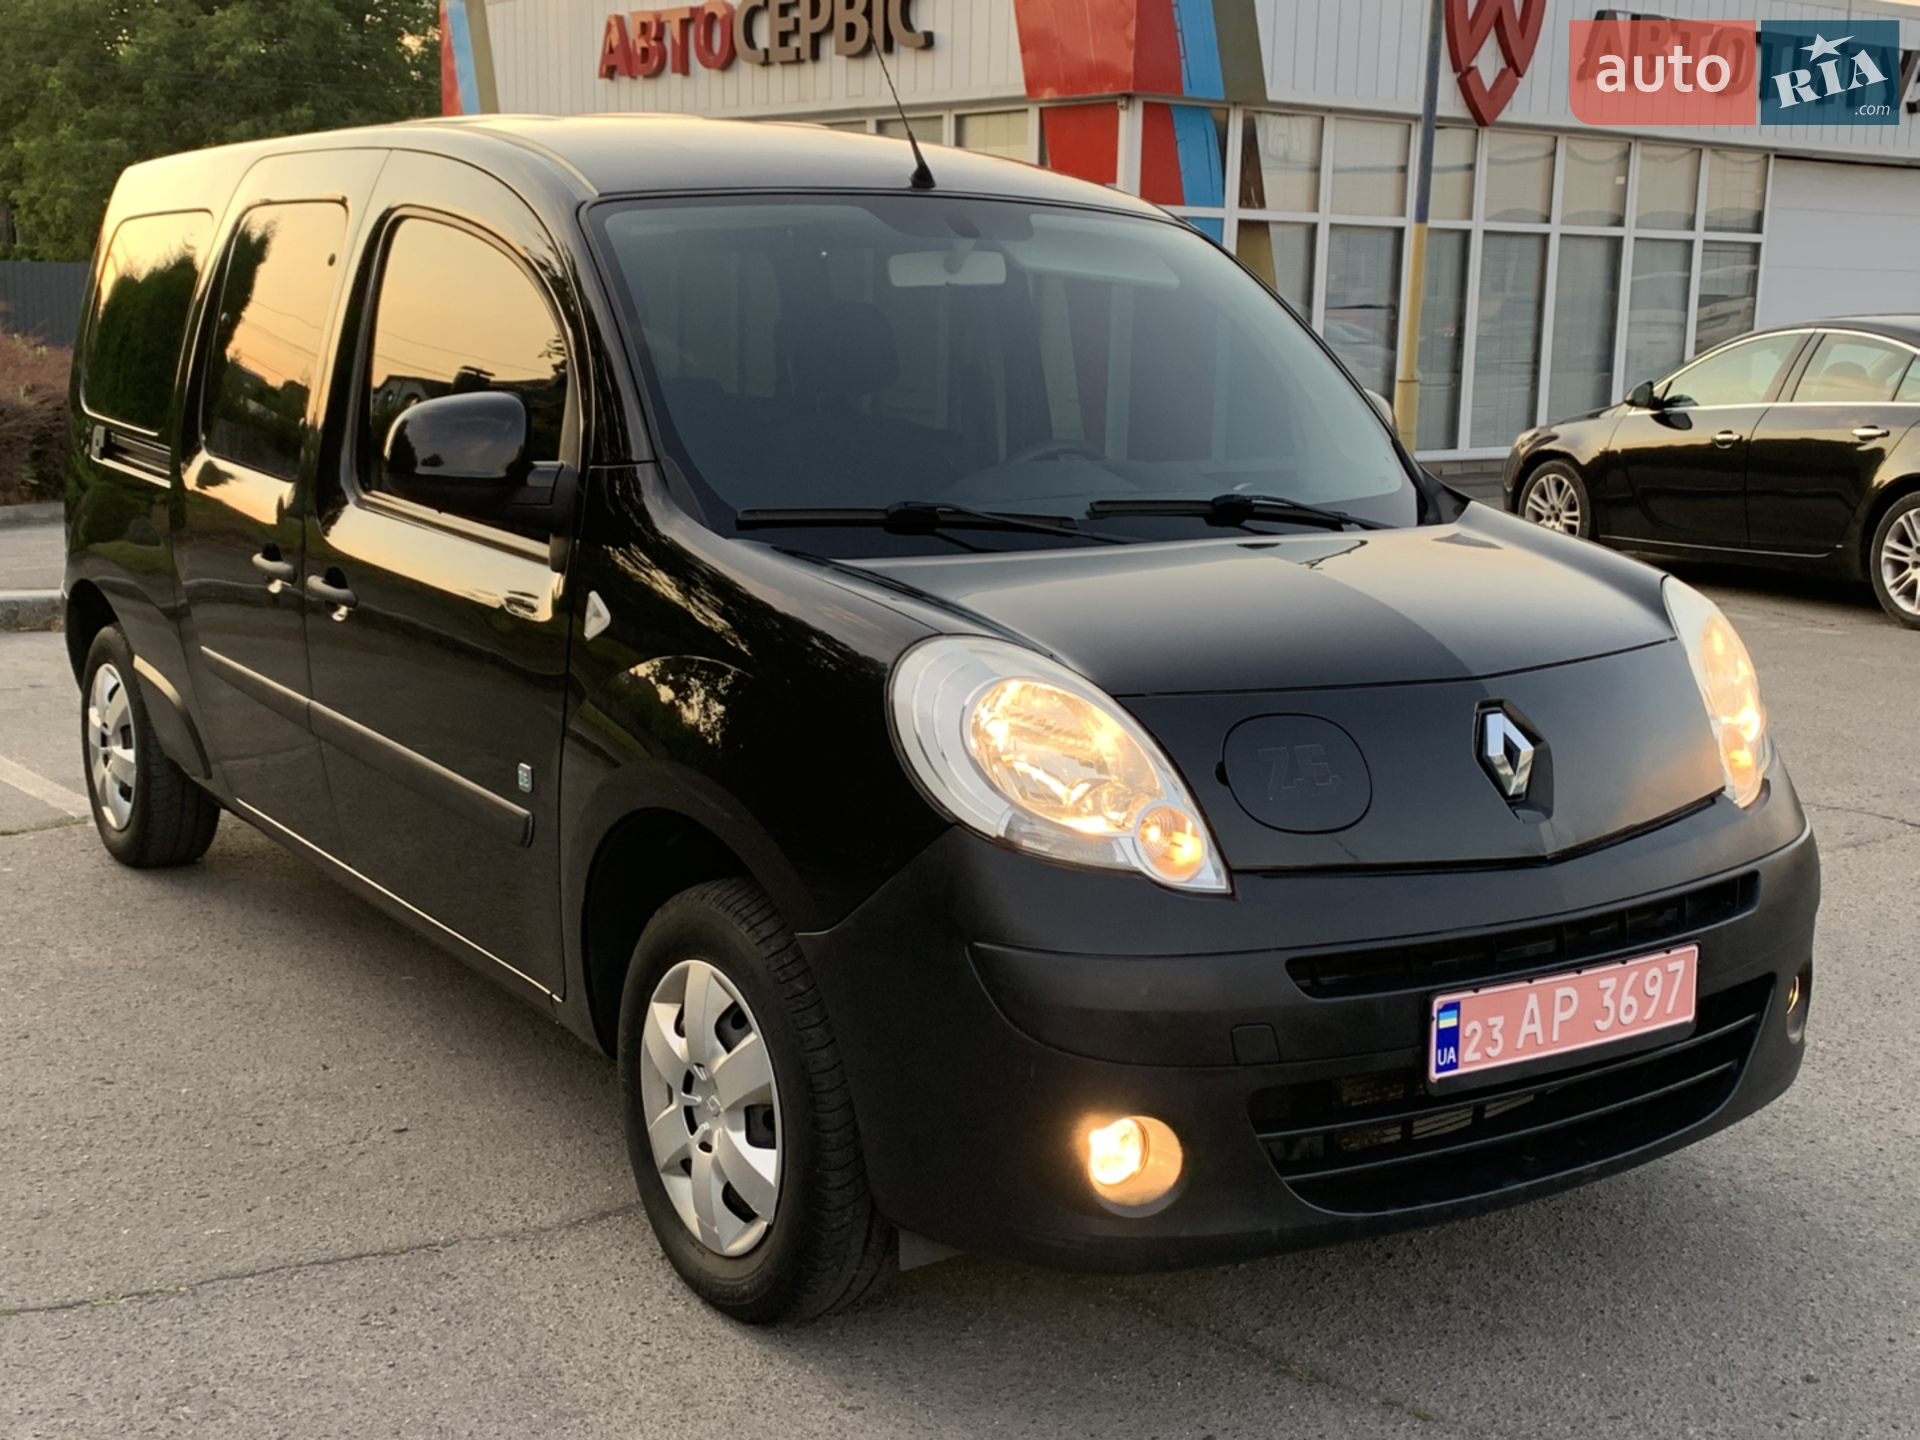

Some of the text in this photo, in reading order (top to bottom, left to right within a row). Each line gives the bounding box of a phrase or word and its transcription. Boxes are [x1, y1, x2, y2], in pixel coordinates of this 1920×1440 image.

[1463, 960, 1686, 1063] 23 AP 3697
[1437, 1046, 1457, 1066] UA
